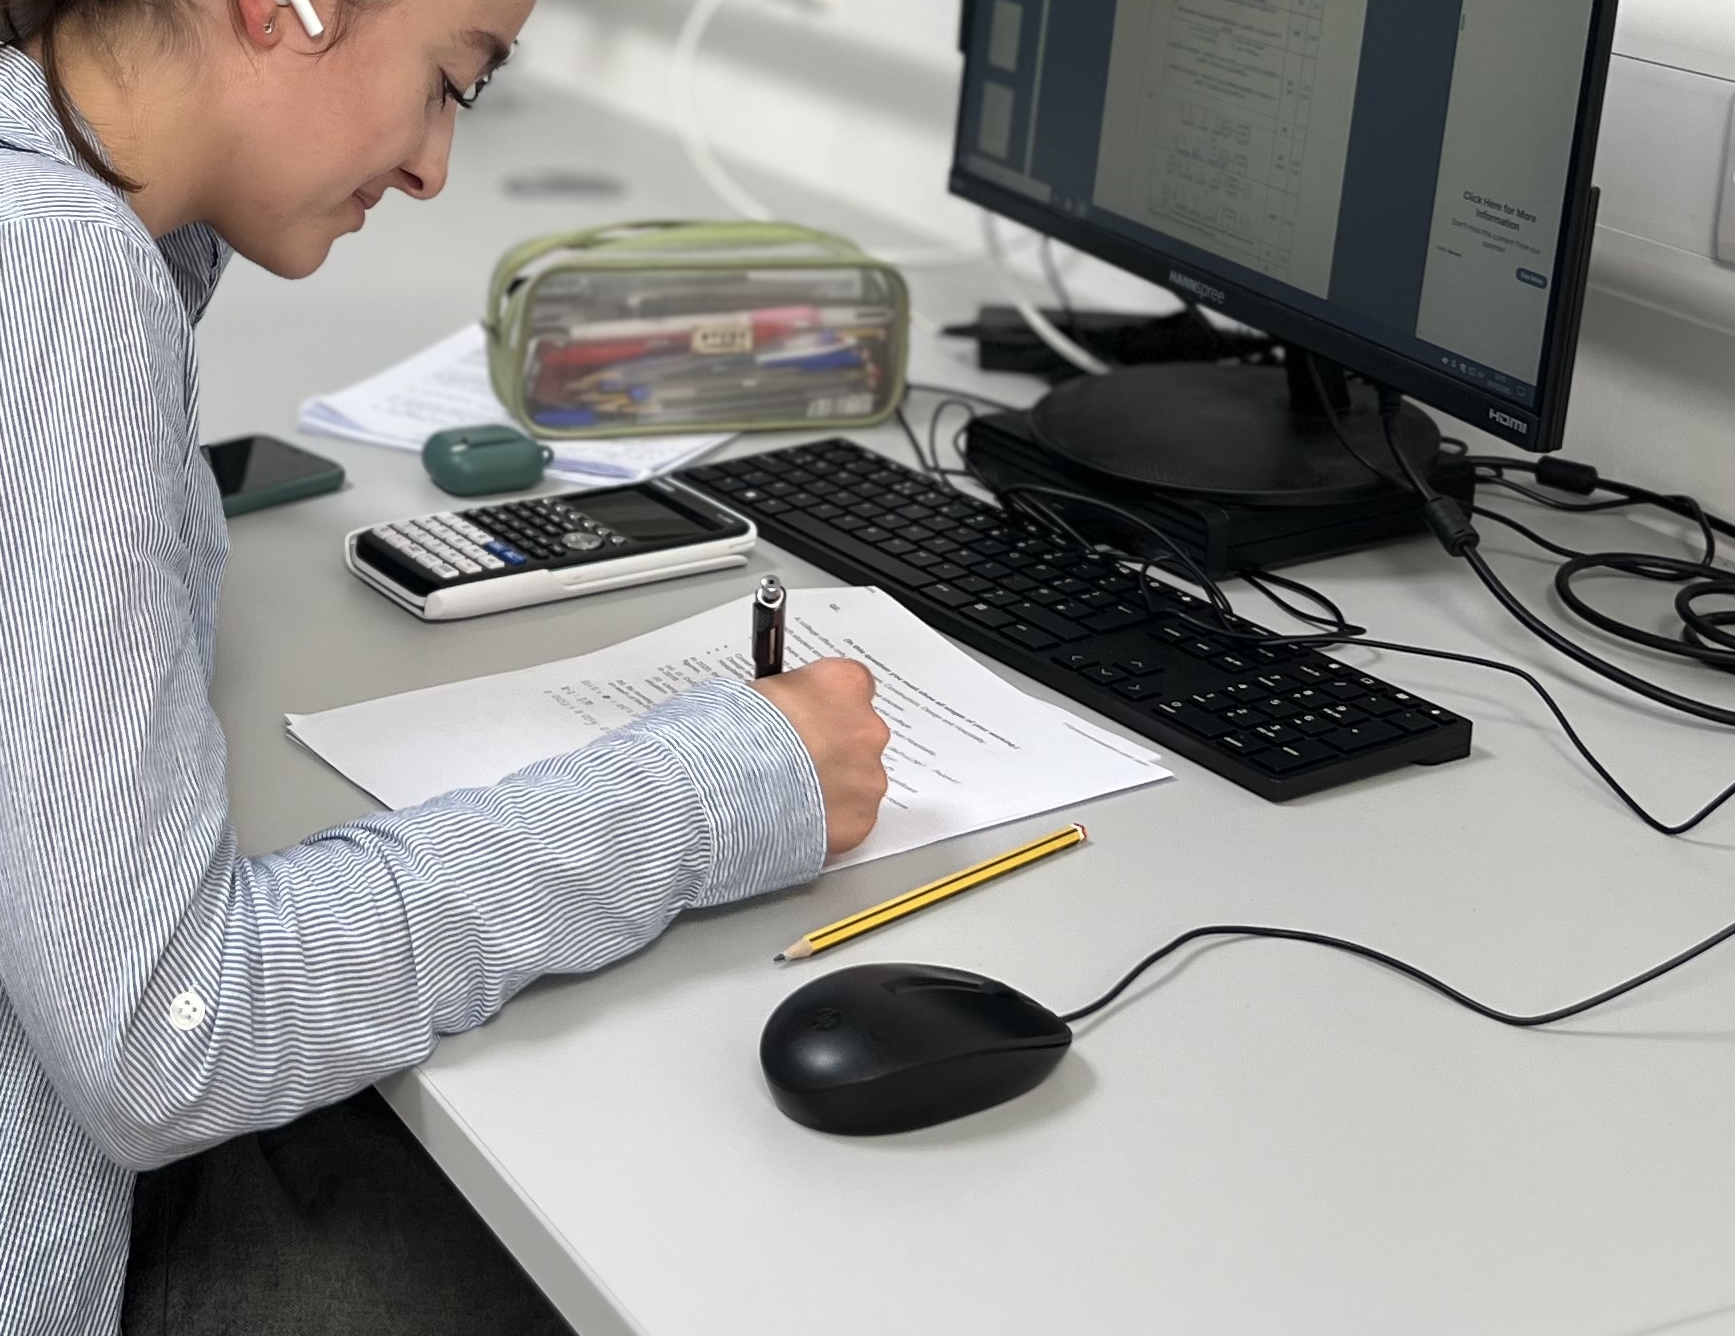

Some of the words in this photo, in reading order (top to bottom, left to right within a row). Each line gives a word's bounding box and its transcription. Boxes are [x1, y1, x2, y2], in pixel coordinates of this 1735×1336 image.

[1463, 190, 1483, 205] Click
[1483, 197, 1502, 212] Here
[1503, 204, 1515, 215] for
[1516, 208, 1537, 223] More
[1475, 208, 1520, 231] Information
[1169, 269, 1225, 304] HANNspree
[1488, 408, 1528, 434] HDMI
[798, 620, 819, 637] college
[817, 635, 835, 649] offers
[920, 706, 943, 720] Design
[941, 717, 956, 727] and
[853, 644, 865, 654] this
[864, 653, 891, 674] question
[889, 671, 903, 682] you
[902, 678, 919, 691] must
[918, 689, 935, 702] show
[972, 722, 990, 733] your
